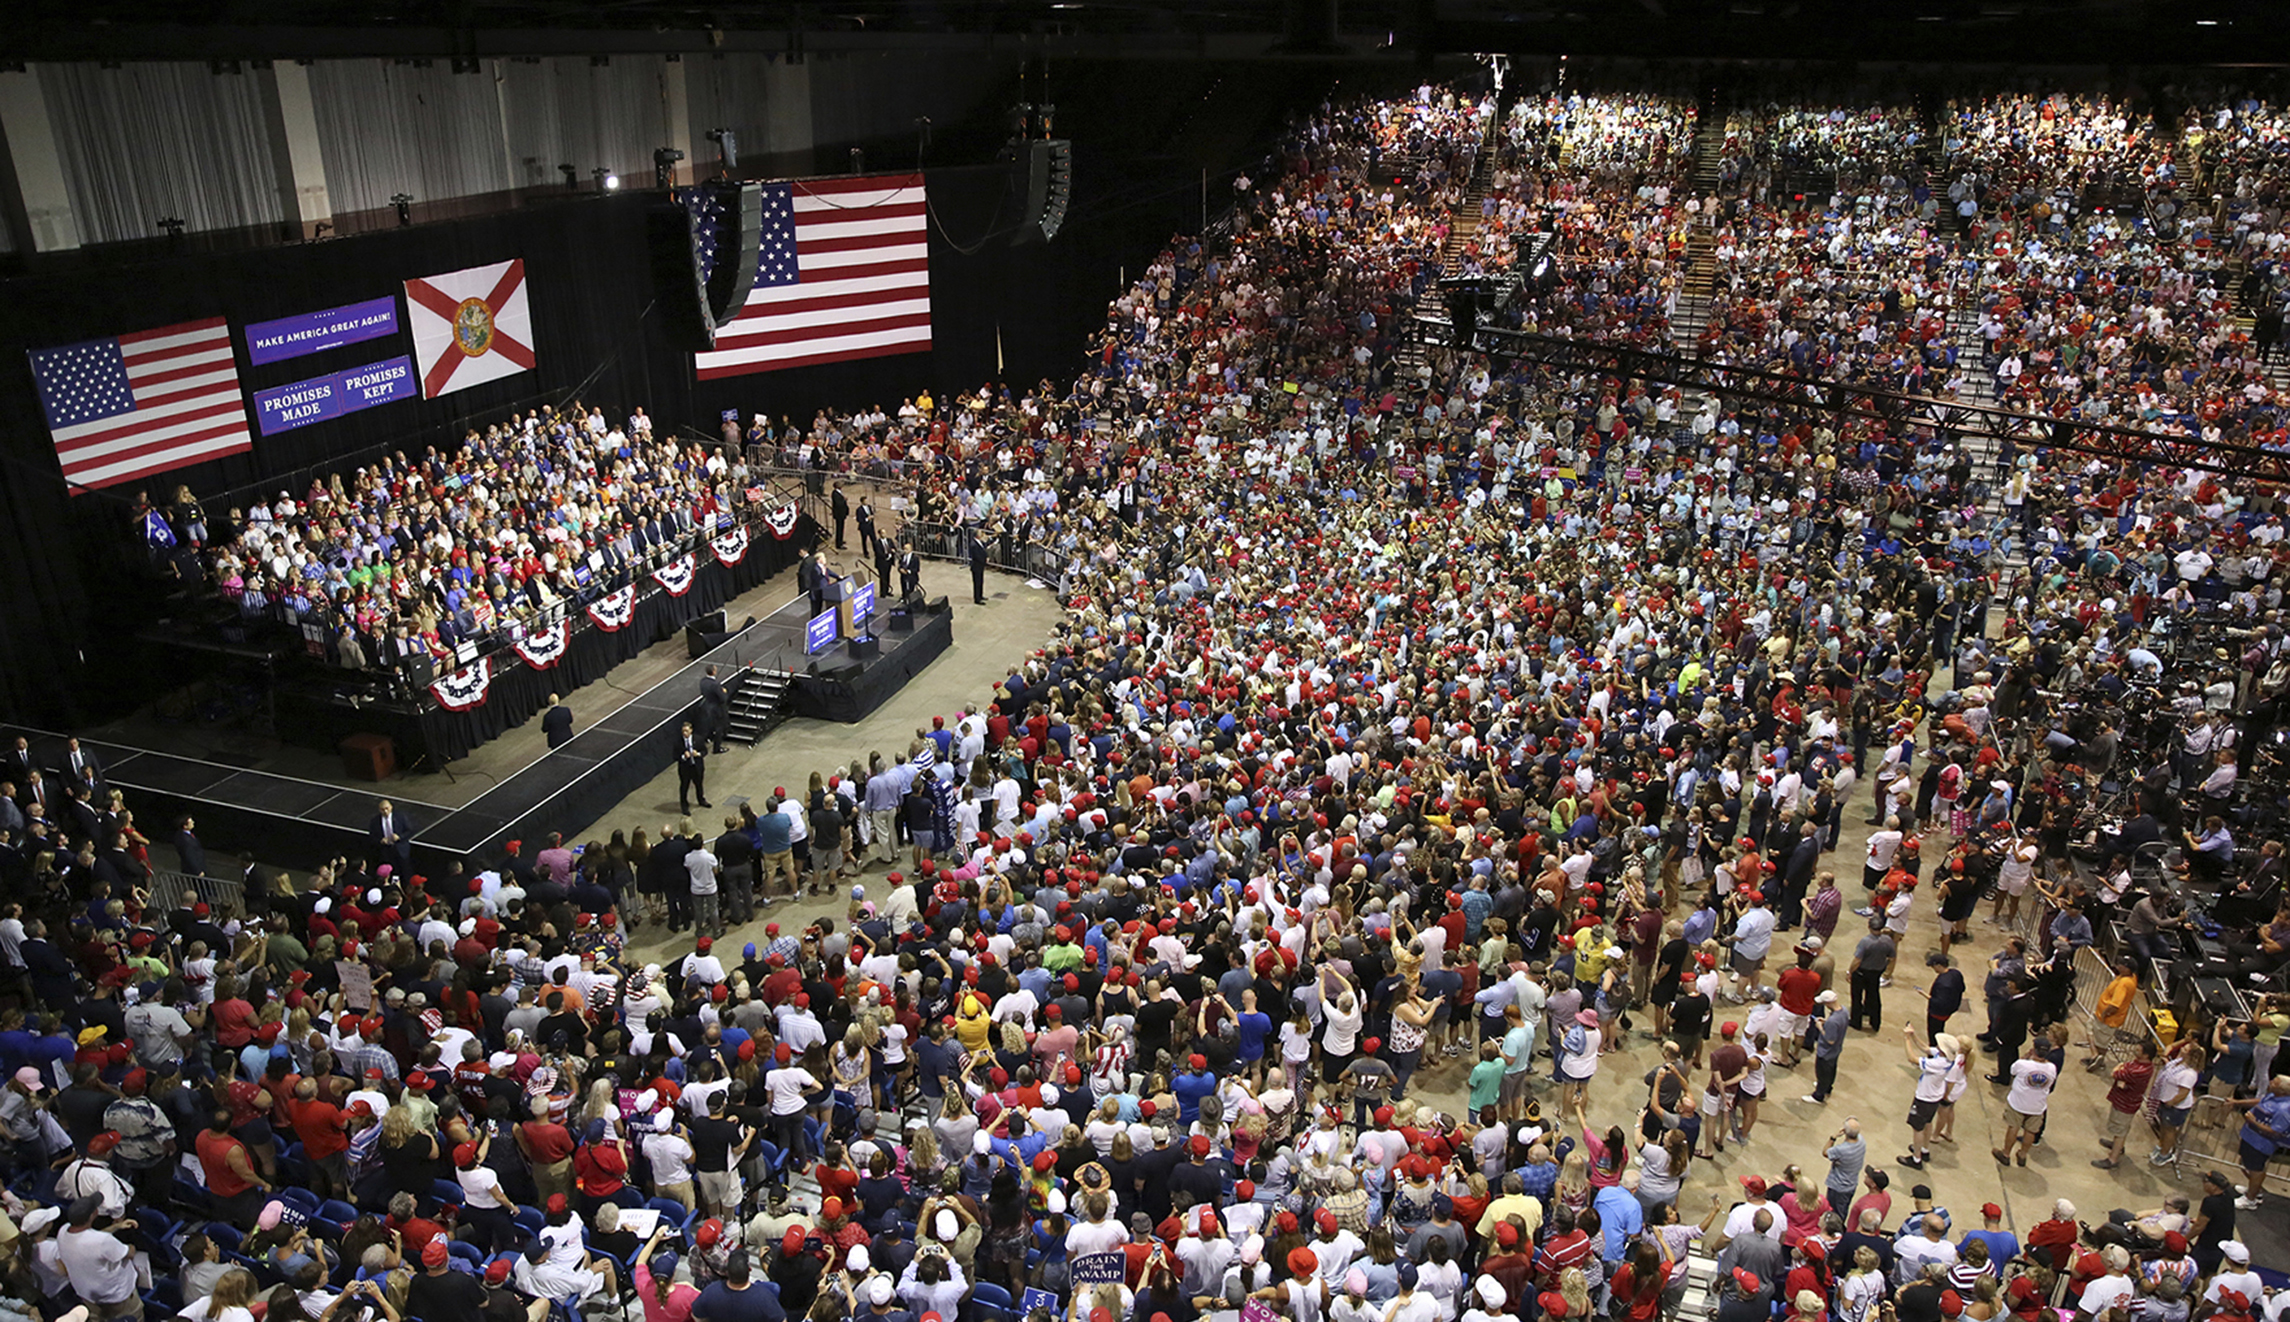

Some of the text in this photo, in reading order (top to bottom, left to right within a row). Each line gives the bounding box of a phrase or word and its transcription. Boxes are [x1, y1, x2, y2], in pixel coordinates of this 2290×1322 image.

[256, 312, 391, 349] MAKE AMERICA GREAT AGAIN!
[345, 365, 406, 391] PROMISES
[264, 385, 332, 412] PROMISES
[363, 382, 394, 400] KEPT
[282, 402, 321, 422] MADE
[1360, 1074, 1379, 1091] 17
[1076, 1255, 1119, 1268] DRAIN
[1072, 1270, 1121, 1282] SWAMP
